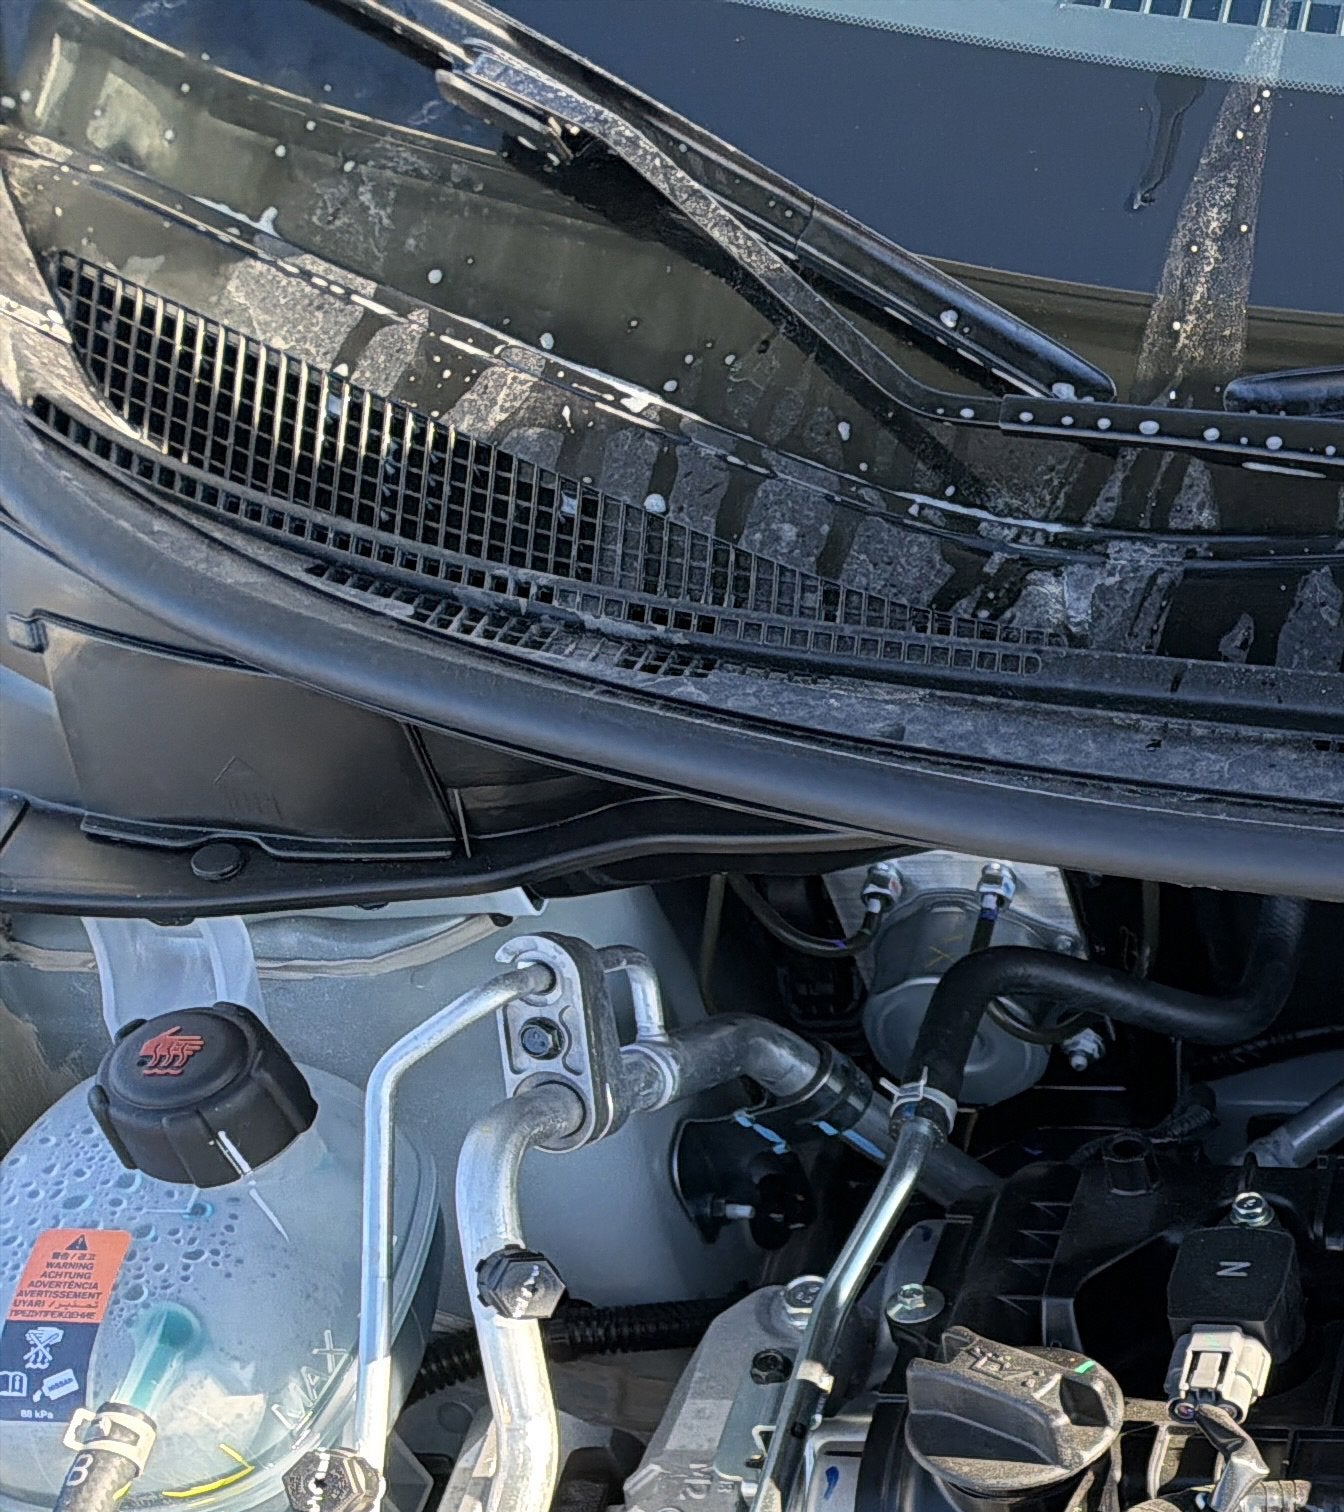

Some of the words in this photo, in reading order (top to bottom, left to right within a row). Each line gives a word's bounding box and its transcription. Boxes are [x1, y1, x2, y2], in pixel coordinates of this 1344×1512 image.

[46, 1261, 94, 1270] WARNING
[40, 1270, 92, 1279] ACHTUNG
[28, 1280, 99, 1290] ADVERTÊNCIA
[16, 1289, 103, 1299] AVERTISSEMENT
[20, 1409, 33, 1419] 88
[34, 1409, 54, 1419] kPa
[66, 1454, 94, 1487] B
